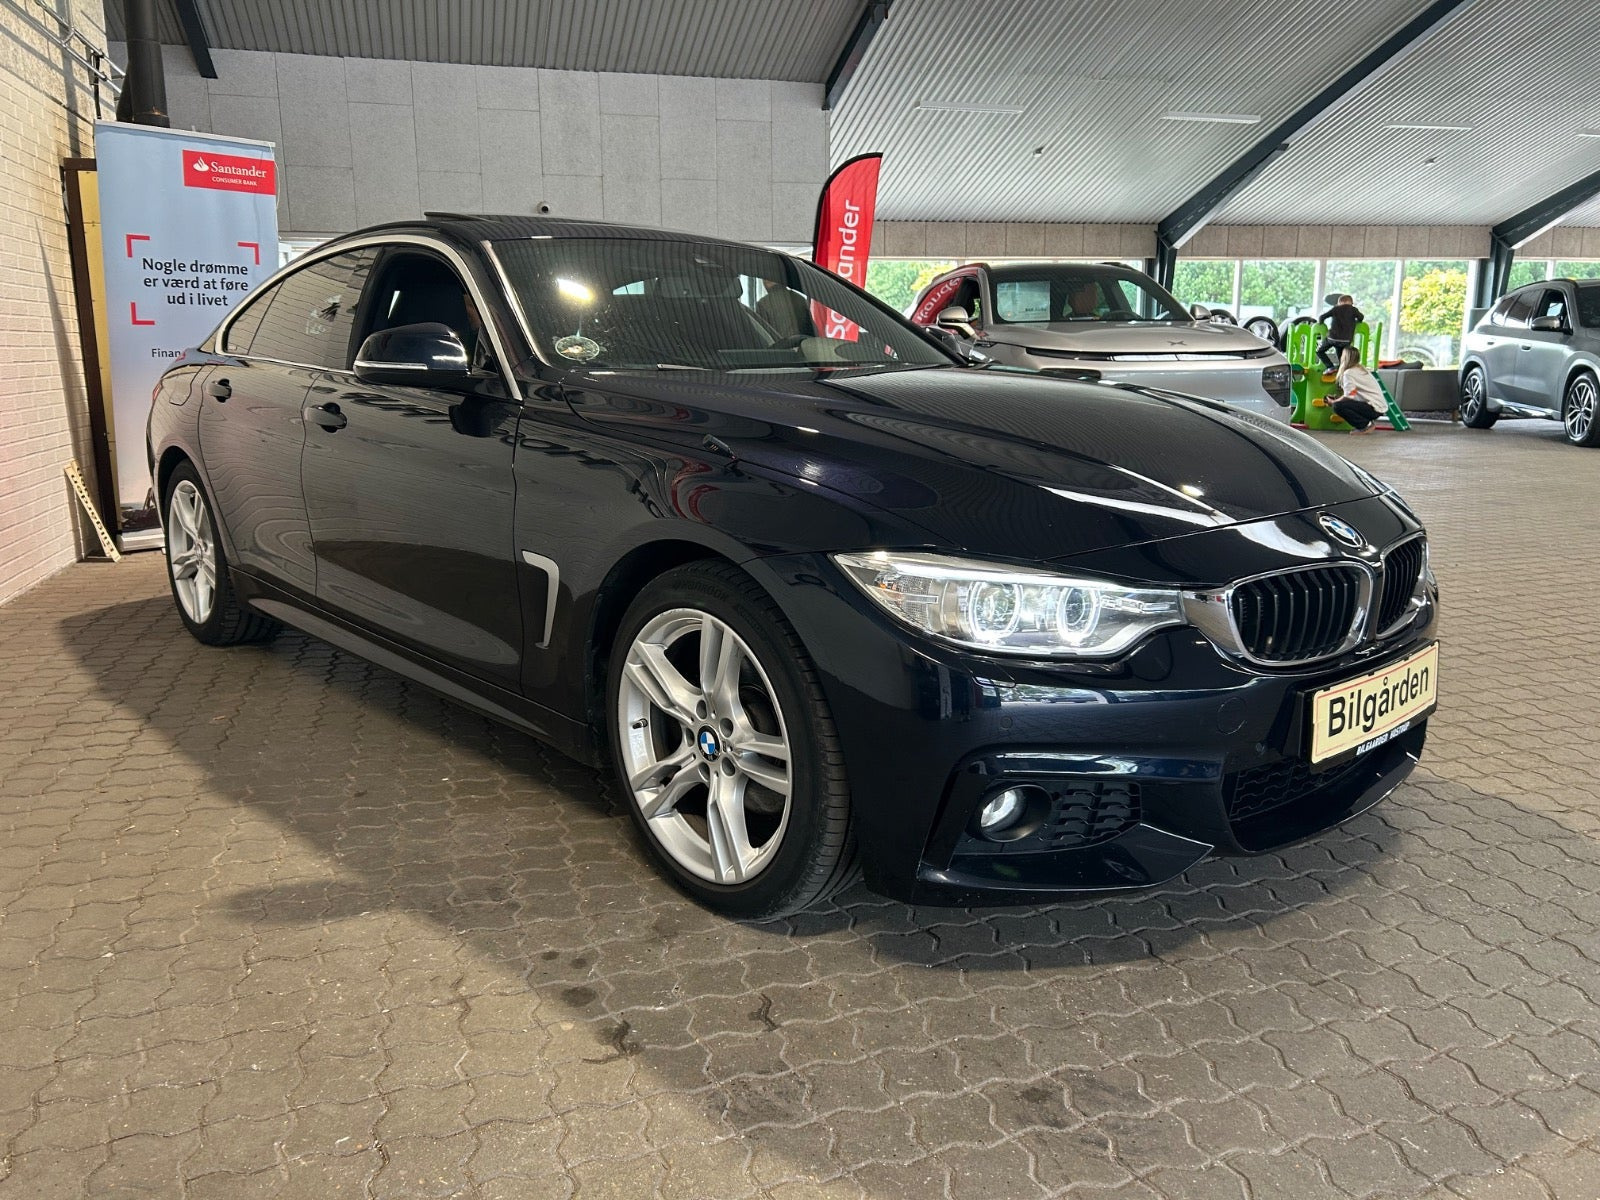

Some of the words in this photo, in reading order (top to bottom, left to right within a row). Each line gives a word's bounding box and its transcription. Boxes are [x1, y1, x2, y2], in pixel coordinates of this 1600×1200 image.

[210, 161, 267, 178] Santander
[211, 176, 243, 185] CONSUMER
[142, 257, 187, 275] Nogle
[189, 260, 249, 275] drømme
[825, 199, 861, 340] Saander
[143, 278, 158, 288] er
[163, 277, 199, 289] værd
[203, 280, 217, 290] at
[220, 279, 249, 291] føre
[167, 292, 186, 305] ud
[189, 293, 194, 305] i
[197, 293, 228, 306] livet
[151, 348, 182, 358] Finan
[1327, 665, 1429, 738] Bilgården
